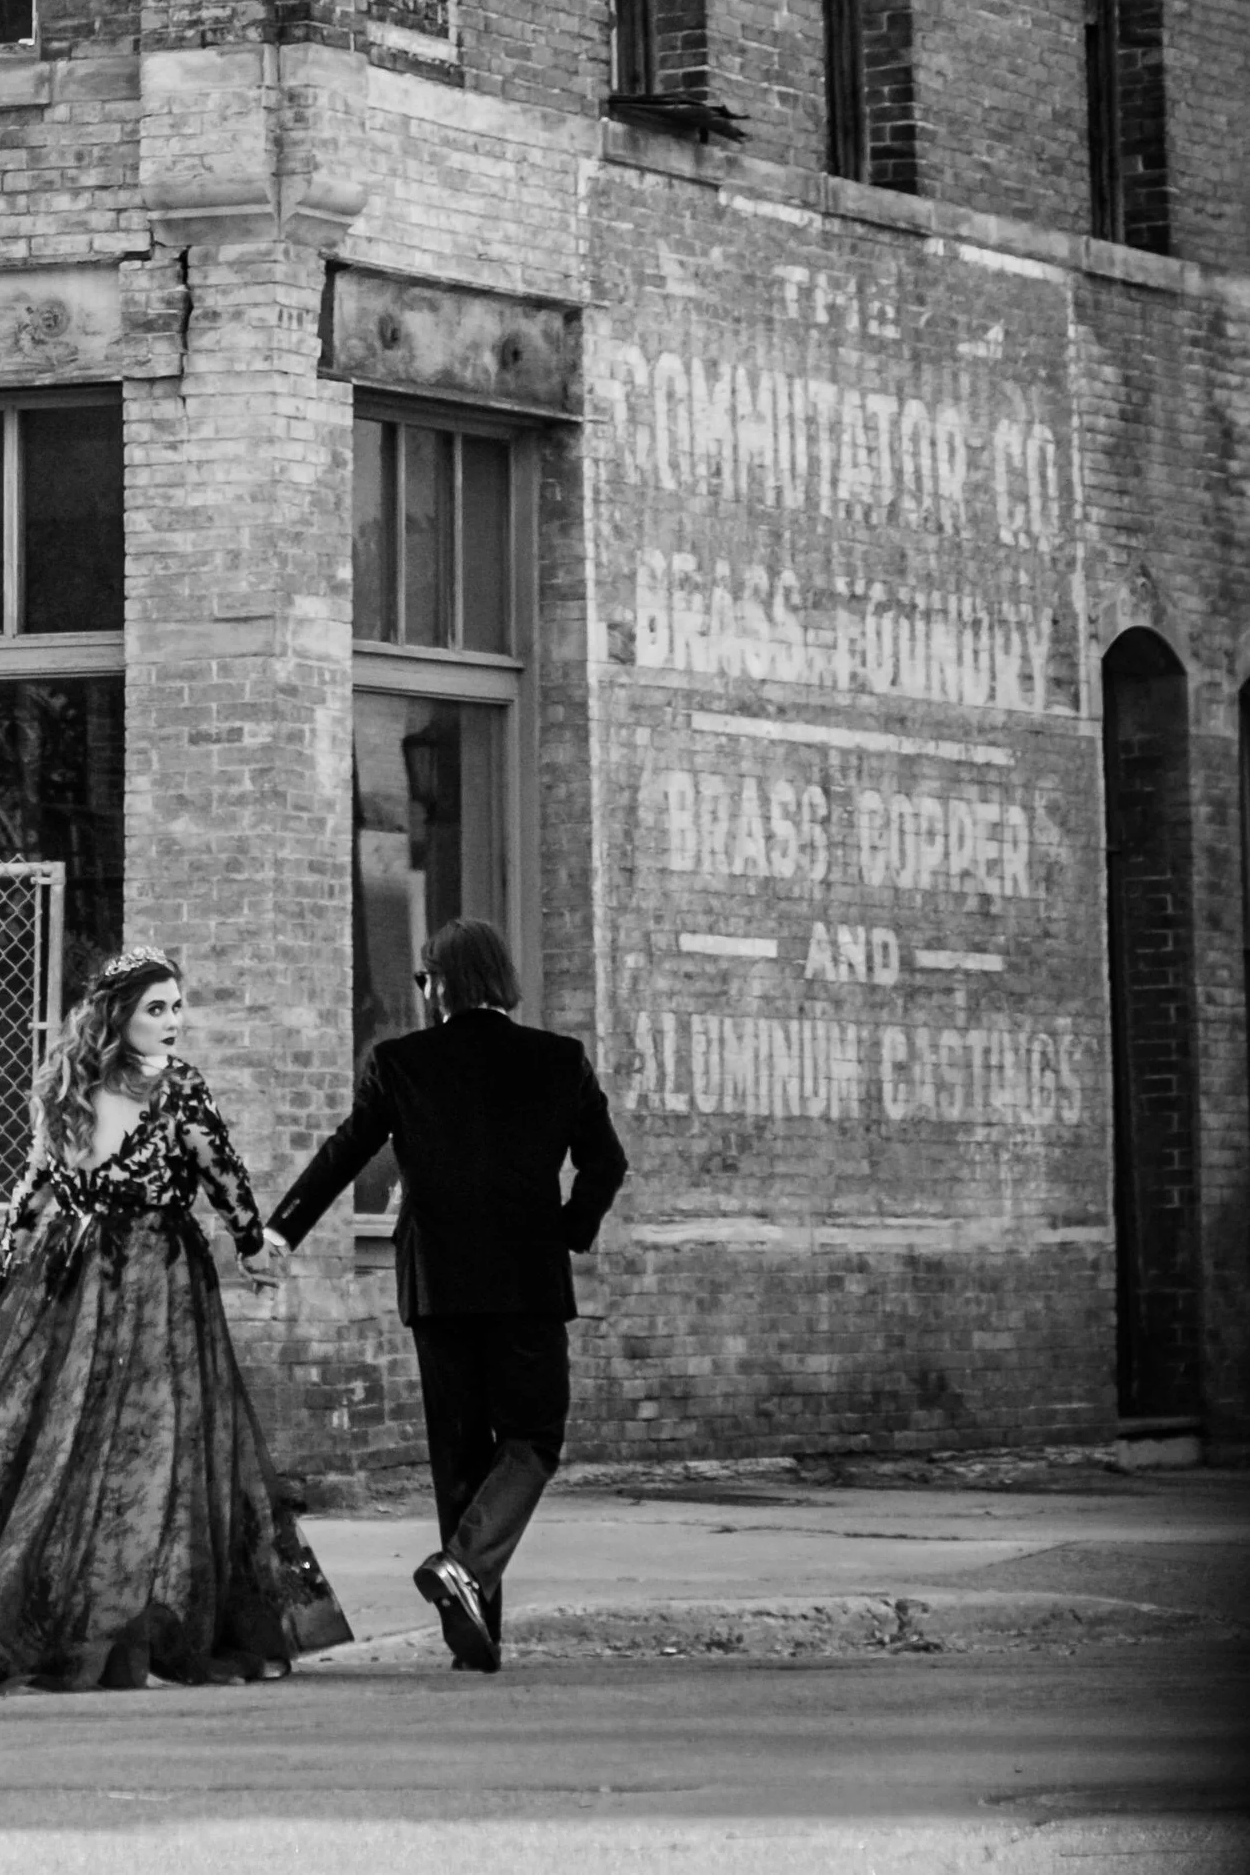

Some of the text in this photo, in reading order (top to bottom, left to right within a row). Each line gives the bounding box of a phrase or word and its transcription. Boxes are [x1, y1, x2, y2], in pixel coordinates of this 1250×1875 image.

[661, 770, 1031, 898] BRASS COPPER
[803, 921, 901, 987] AND
[624, 1011, 863, 1121] ALUMINUM
